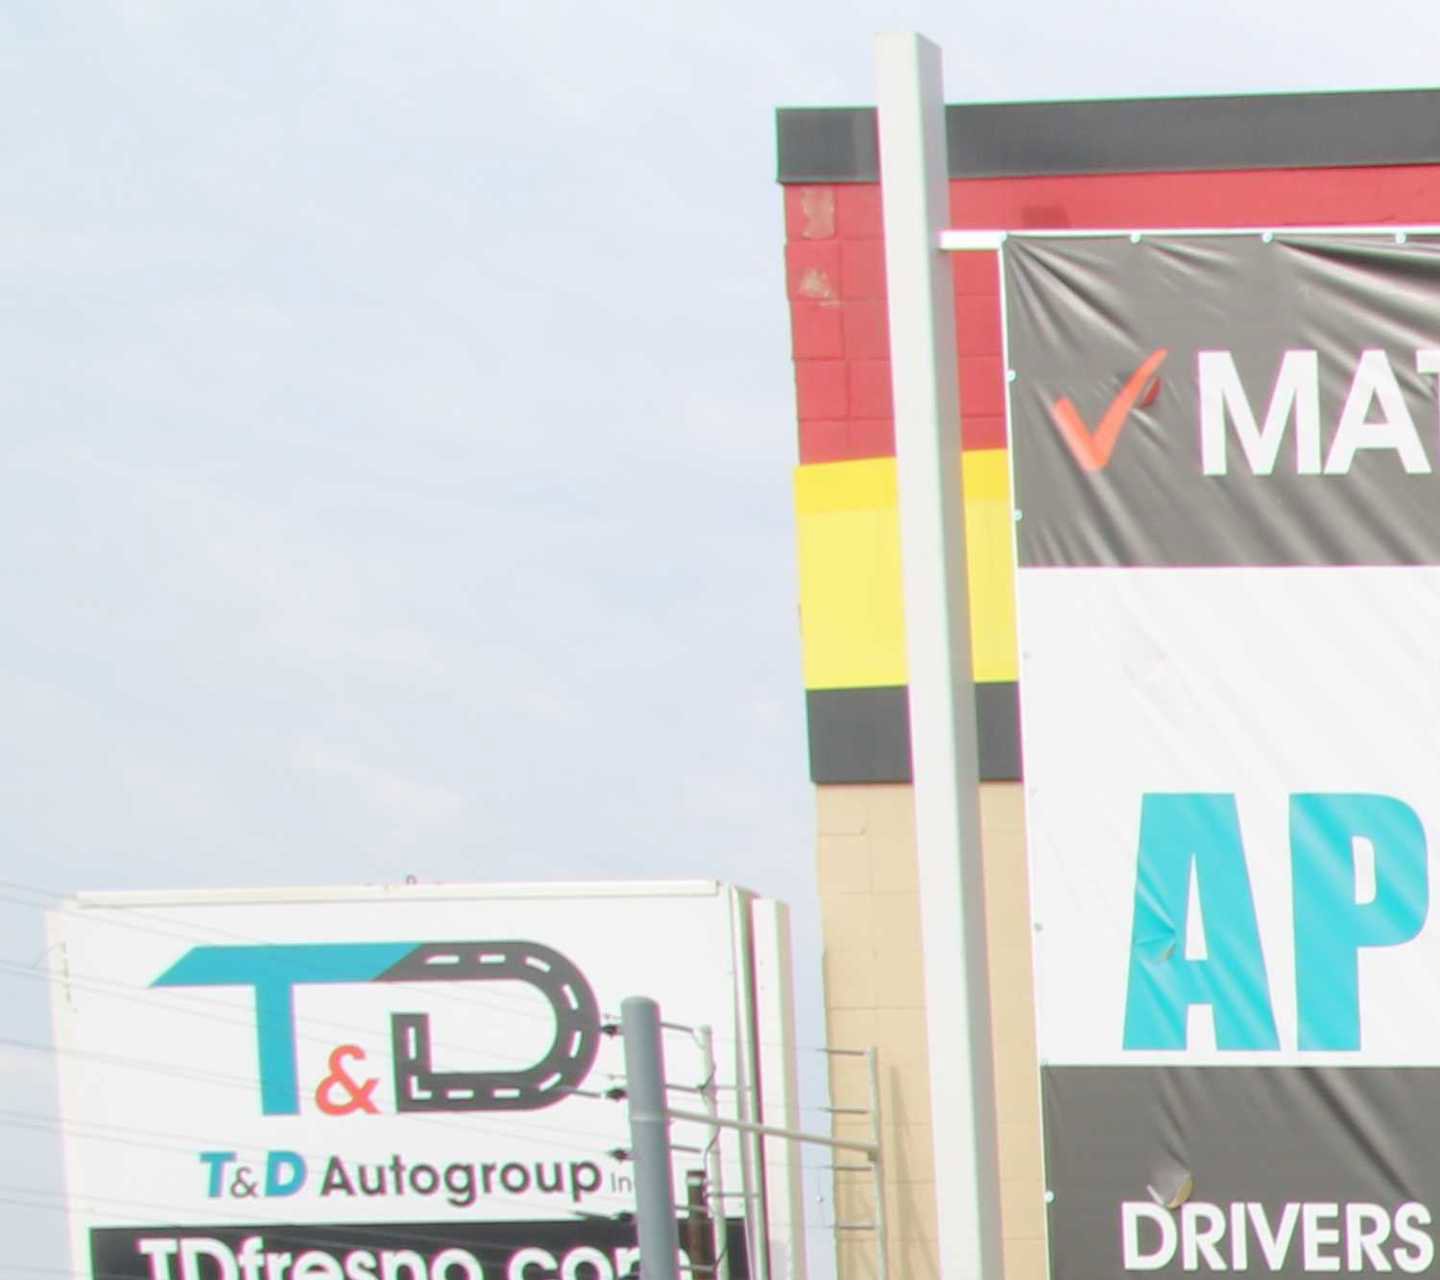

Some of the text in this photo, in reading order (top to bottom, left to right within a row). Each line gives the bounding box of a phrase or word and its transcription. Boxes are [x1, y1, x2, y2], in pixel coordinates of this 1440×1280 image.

[200, 1150, 633, 1207] T&D Autogroup In
[1120, 1201, 1436, 1273] DRIVERS
